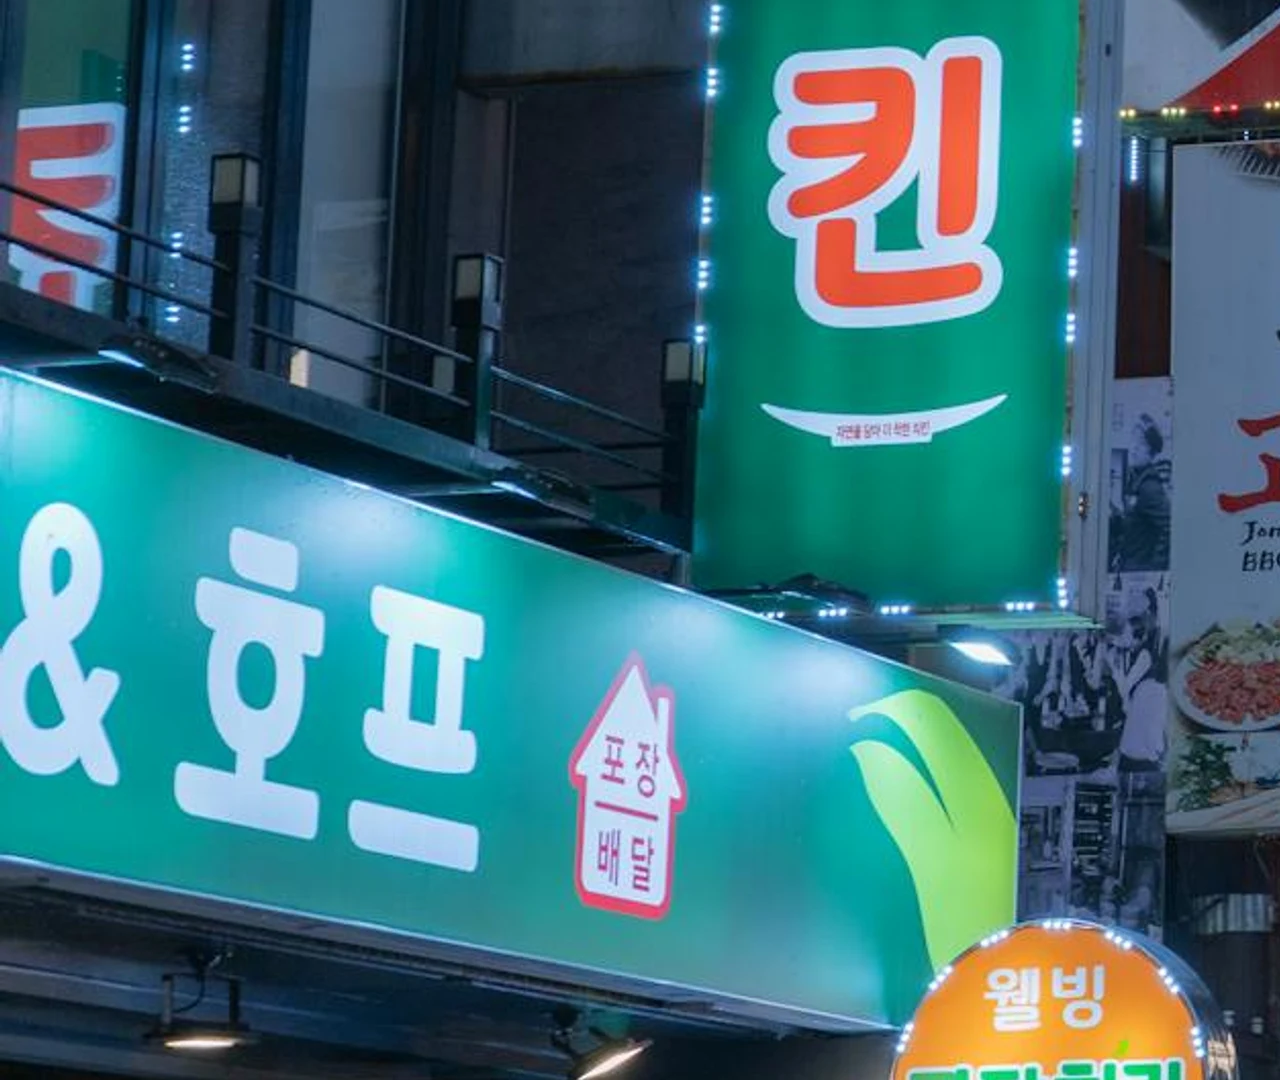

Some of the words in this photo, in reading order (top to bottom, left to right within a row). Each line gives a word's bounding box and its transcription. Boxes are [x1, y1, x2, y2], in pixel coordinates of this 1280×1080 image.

[173, 526, 486, 873] 호프
[601, 734, 661, 799] 포장
[597, 828, 656, 893] 배달
[983, 964, 1107, 1033] 웰빙
